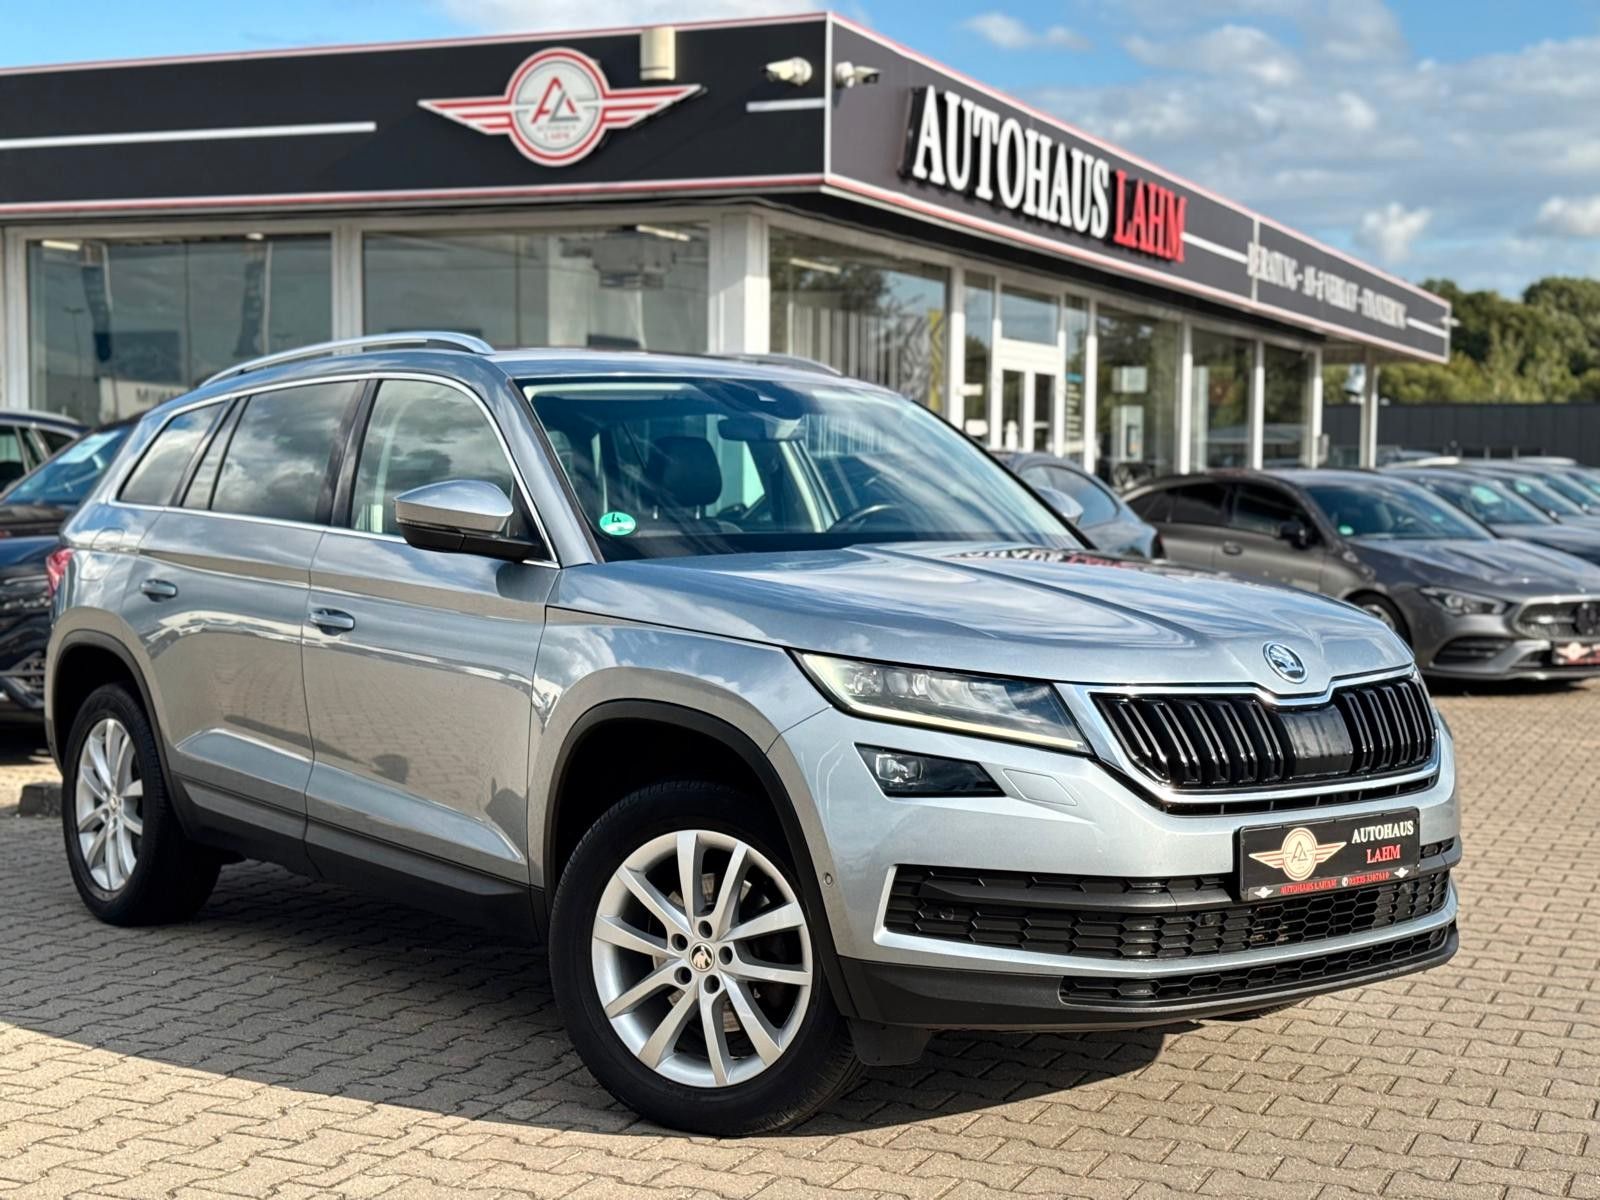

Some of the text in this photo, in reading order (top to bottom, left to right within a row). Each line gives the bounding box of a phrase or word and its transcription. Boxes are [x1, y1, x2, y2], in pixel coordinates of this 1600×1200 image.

[912, 84, 1188, 264] AUTOHAUS LAHM
[611, 513, 622, 523] 4
[1351, 820, 1414, 844] AUTOHAUS
[1366, 844, 1401, 864] LAHM
